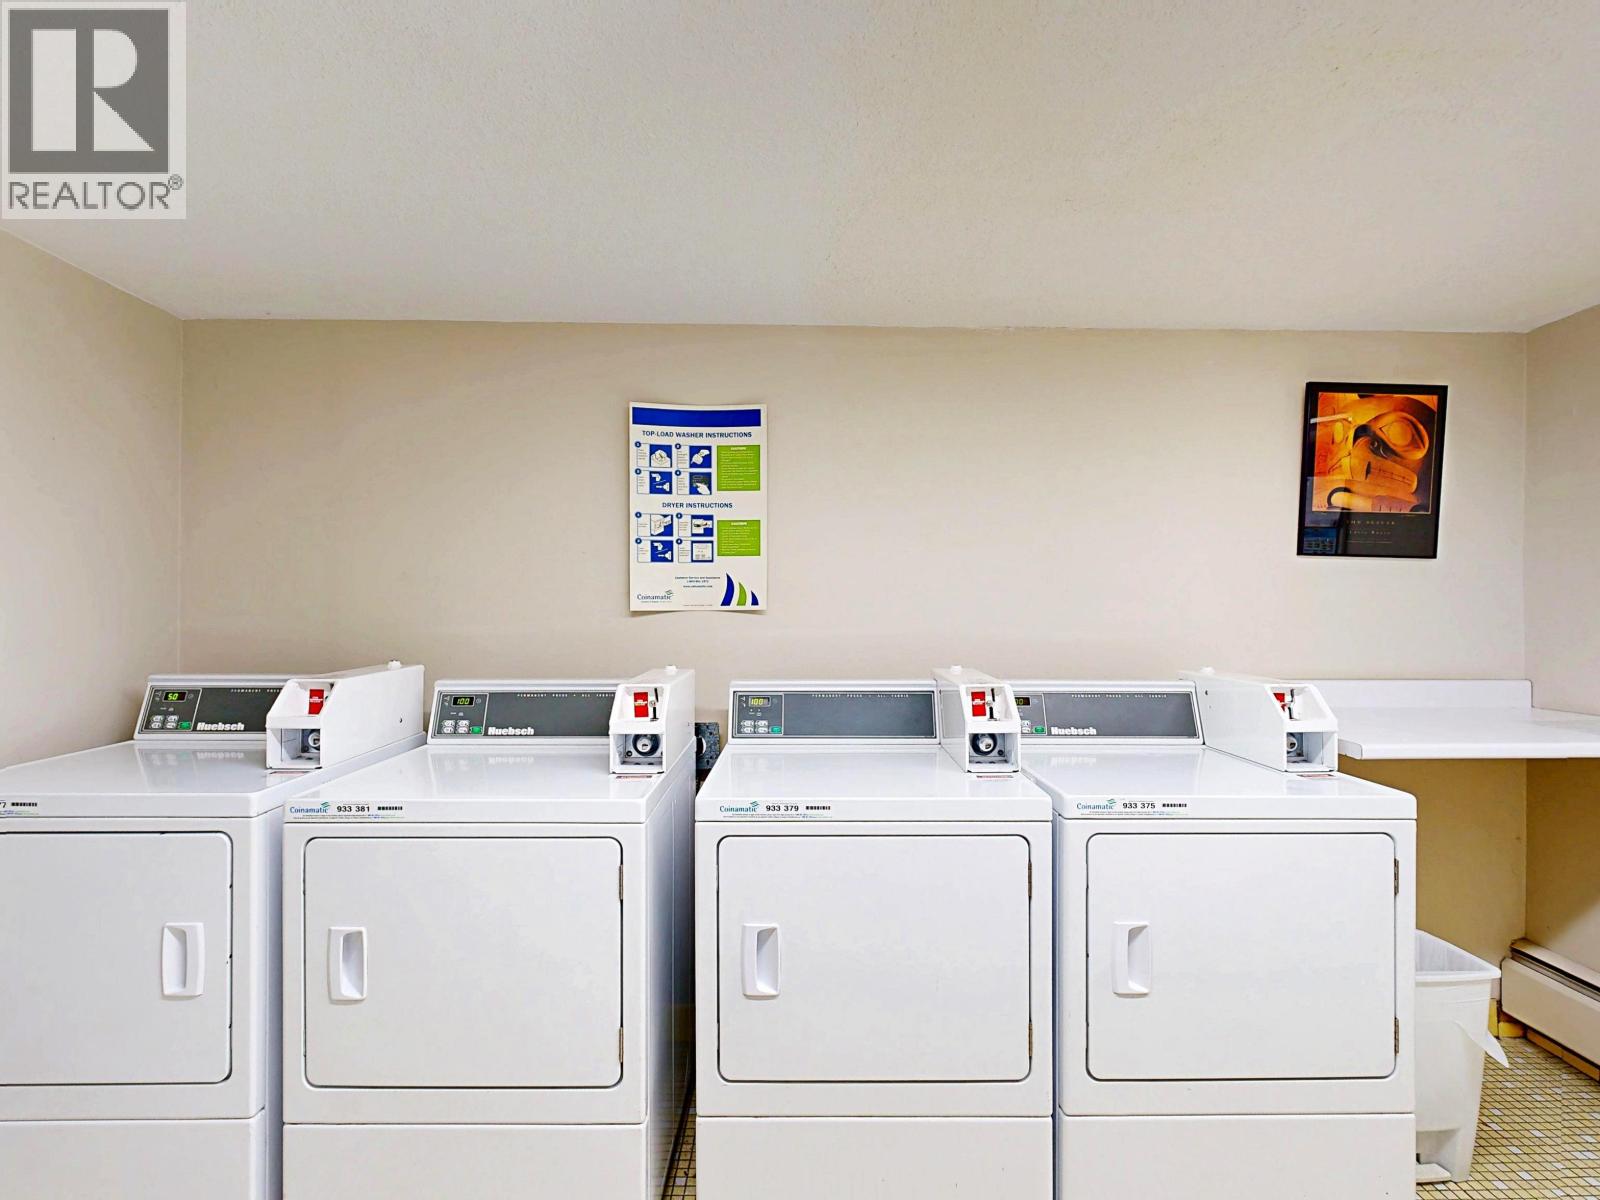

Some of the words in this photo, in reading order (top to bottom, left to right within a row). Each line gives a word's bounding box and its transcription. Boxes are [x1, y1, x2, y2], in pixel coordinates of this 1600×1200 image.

[641, 430, 674, 438] TOP-LOAD
[675, 431, 704, 439] WASHER
[705, 431, 752, 439] INSTRUCTIONS
[167, 693, 179, 701] 50
[751, 697, 764, 705] 100
[196, 722, 245, 731] Huebsch
[487, 726, 535, 735] Huebsch
[1050, 726, 1097, 735] Huebsch
[289, 806, 328, 814] Coinamatic
[336, 805, 352, 813] 933
[355, 805, 370, 813] 381
[719, 805, 758, 813] Coinamatic
[765, 804, 781, 812] 933
[783, 804, 799, 812] 379
[1076, 802, 1115, 810] Coinamatic
[1122, 802, 1138, 810] 933
[1140, 802, 1156, 810] 375
